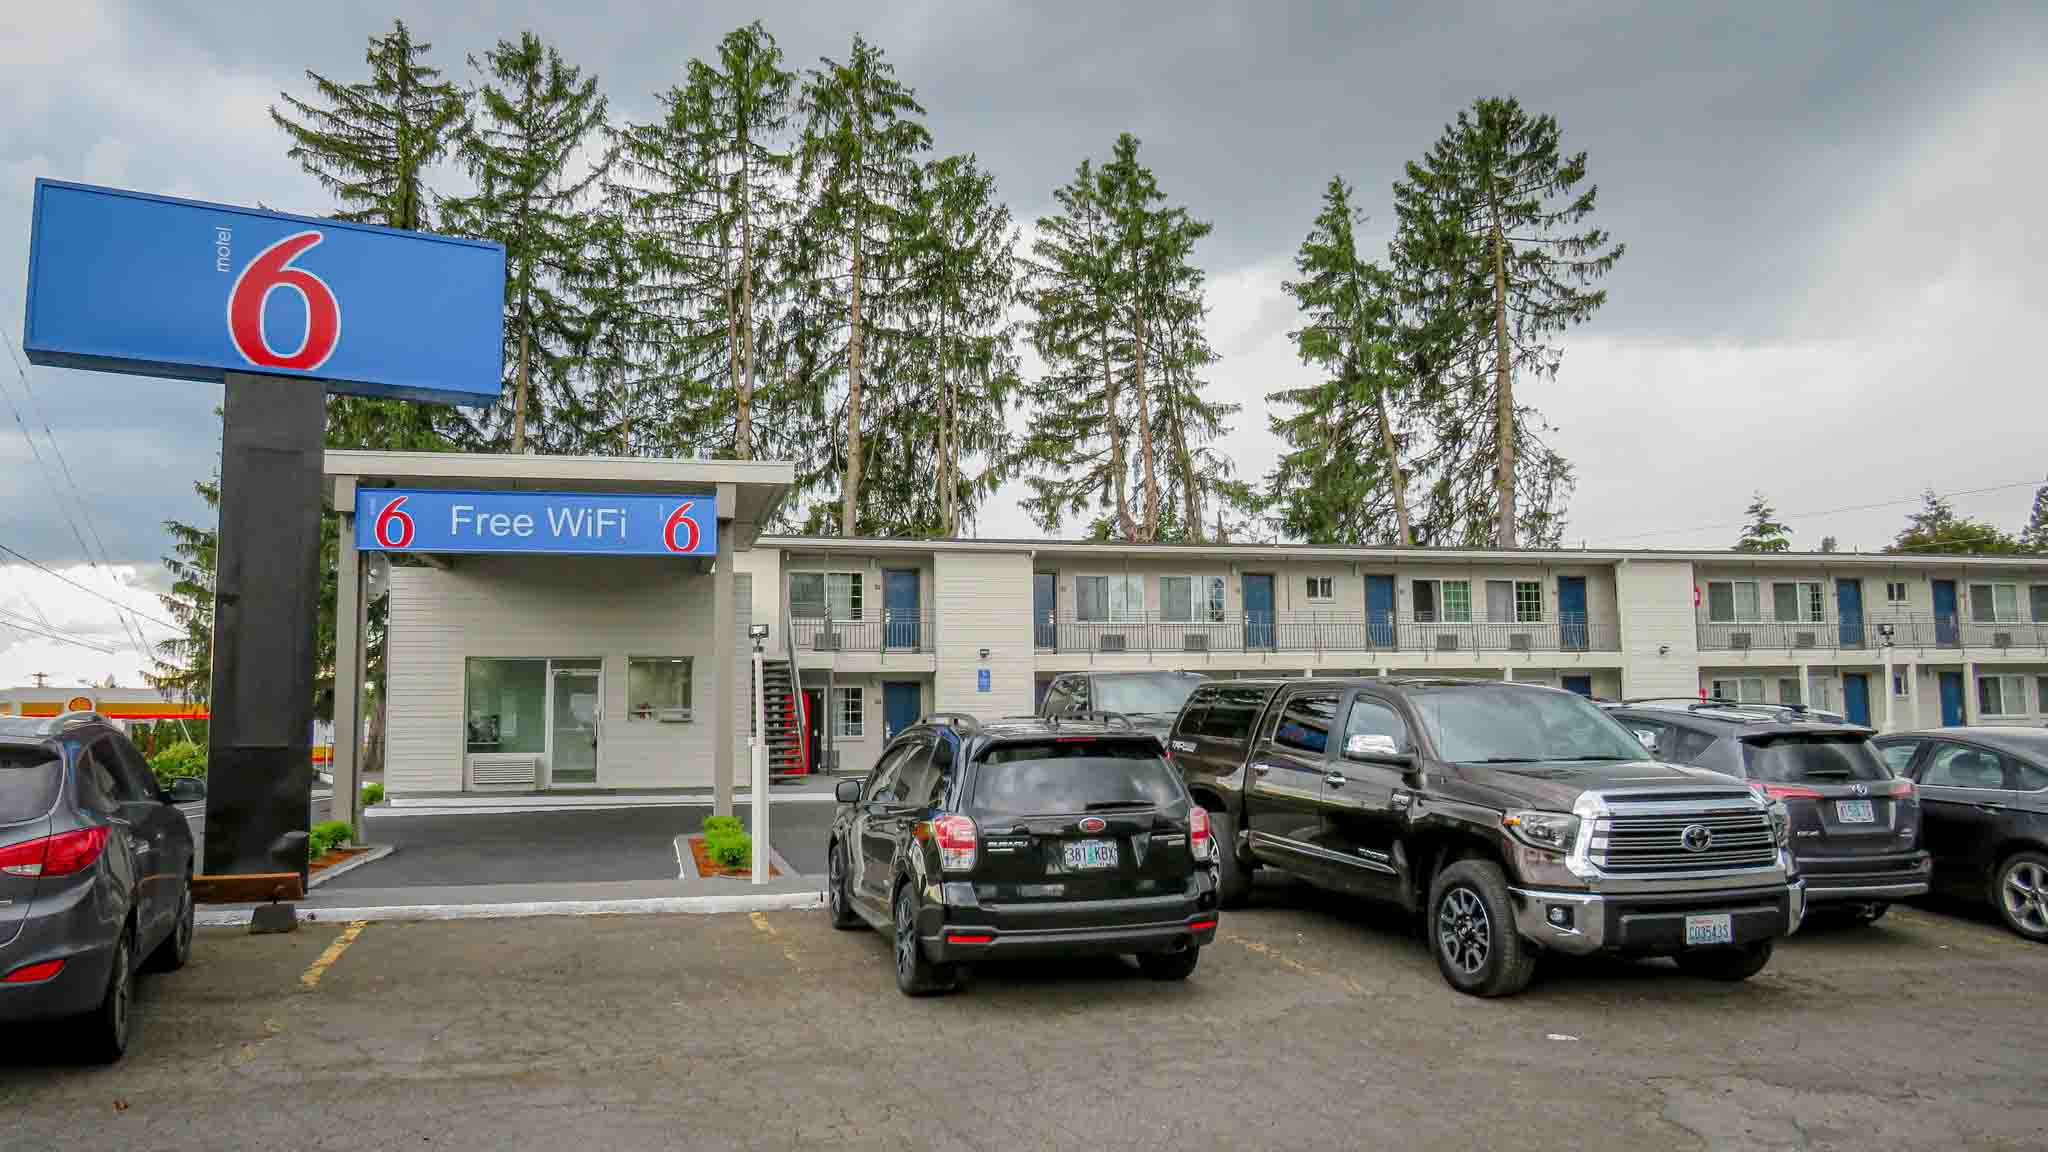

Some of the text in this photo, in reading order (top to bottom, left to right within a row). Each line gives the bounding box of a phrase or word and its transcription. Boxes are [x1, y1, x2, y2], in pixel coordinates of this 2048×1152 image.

[215, 225, 233, 273] motel
[227, 230, 341, 371] 6
[374, 496, 416, 548] 6
[451, 505, 534, 537] Free
[547, 507, 627, 537] WiFi
[663, 501, 701, 552] 6
